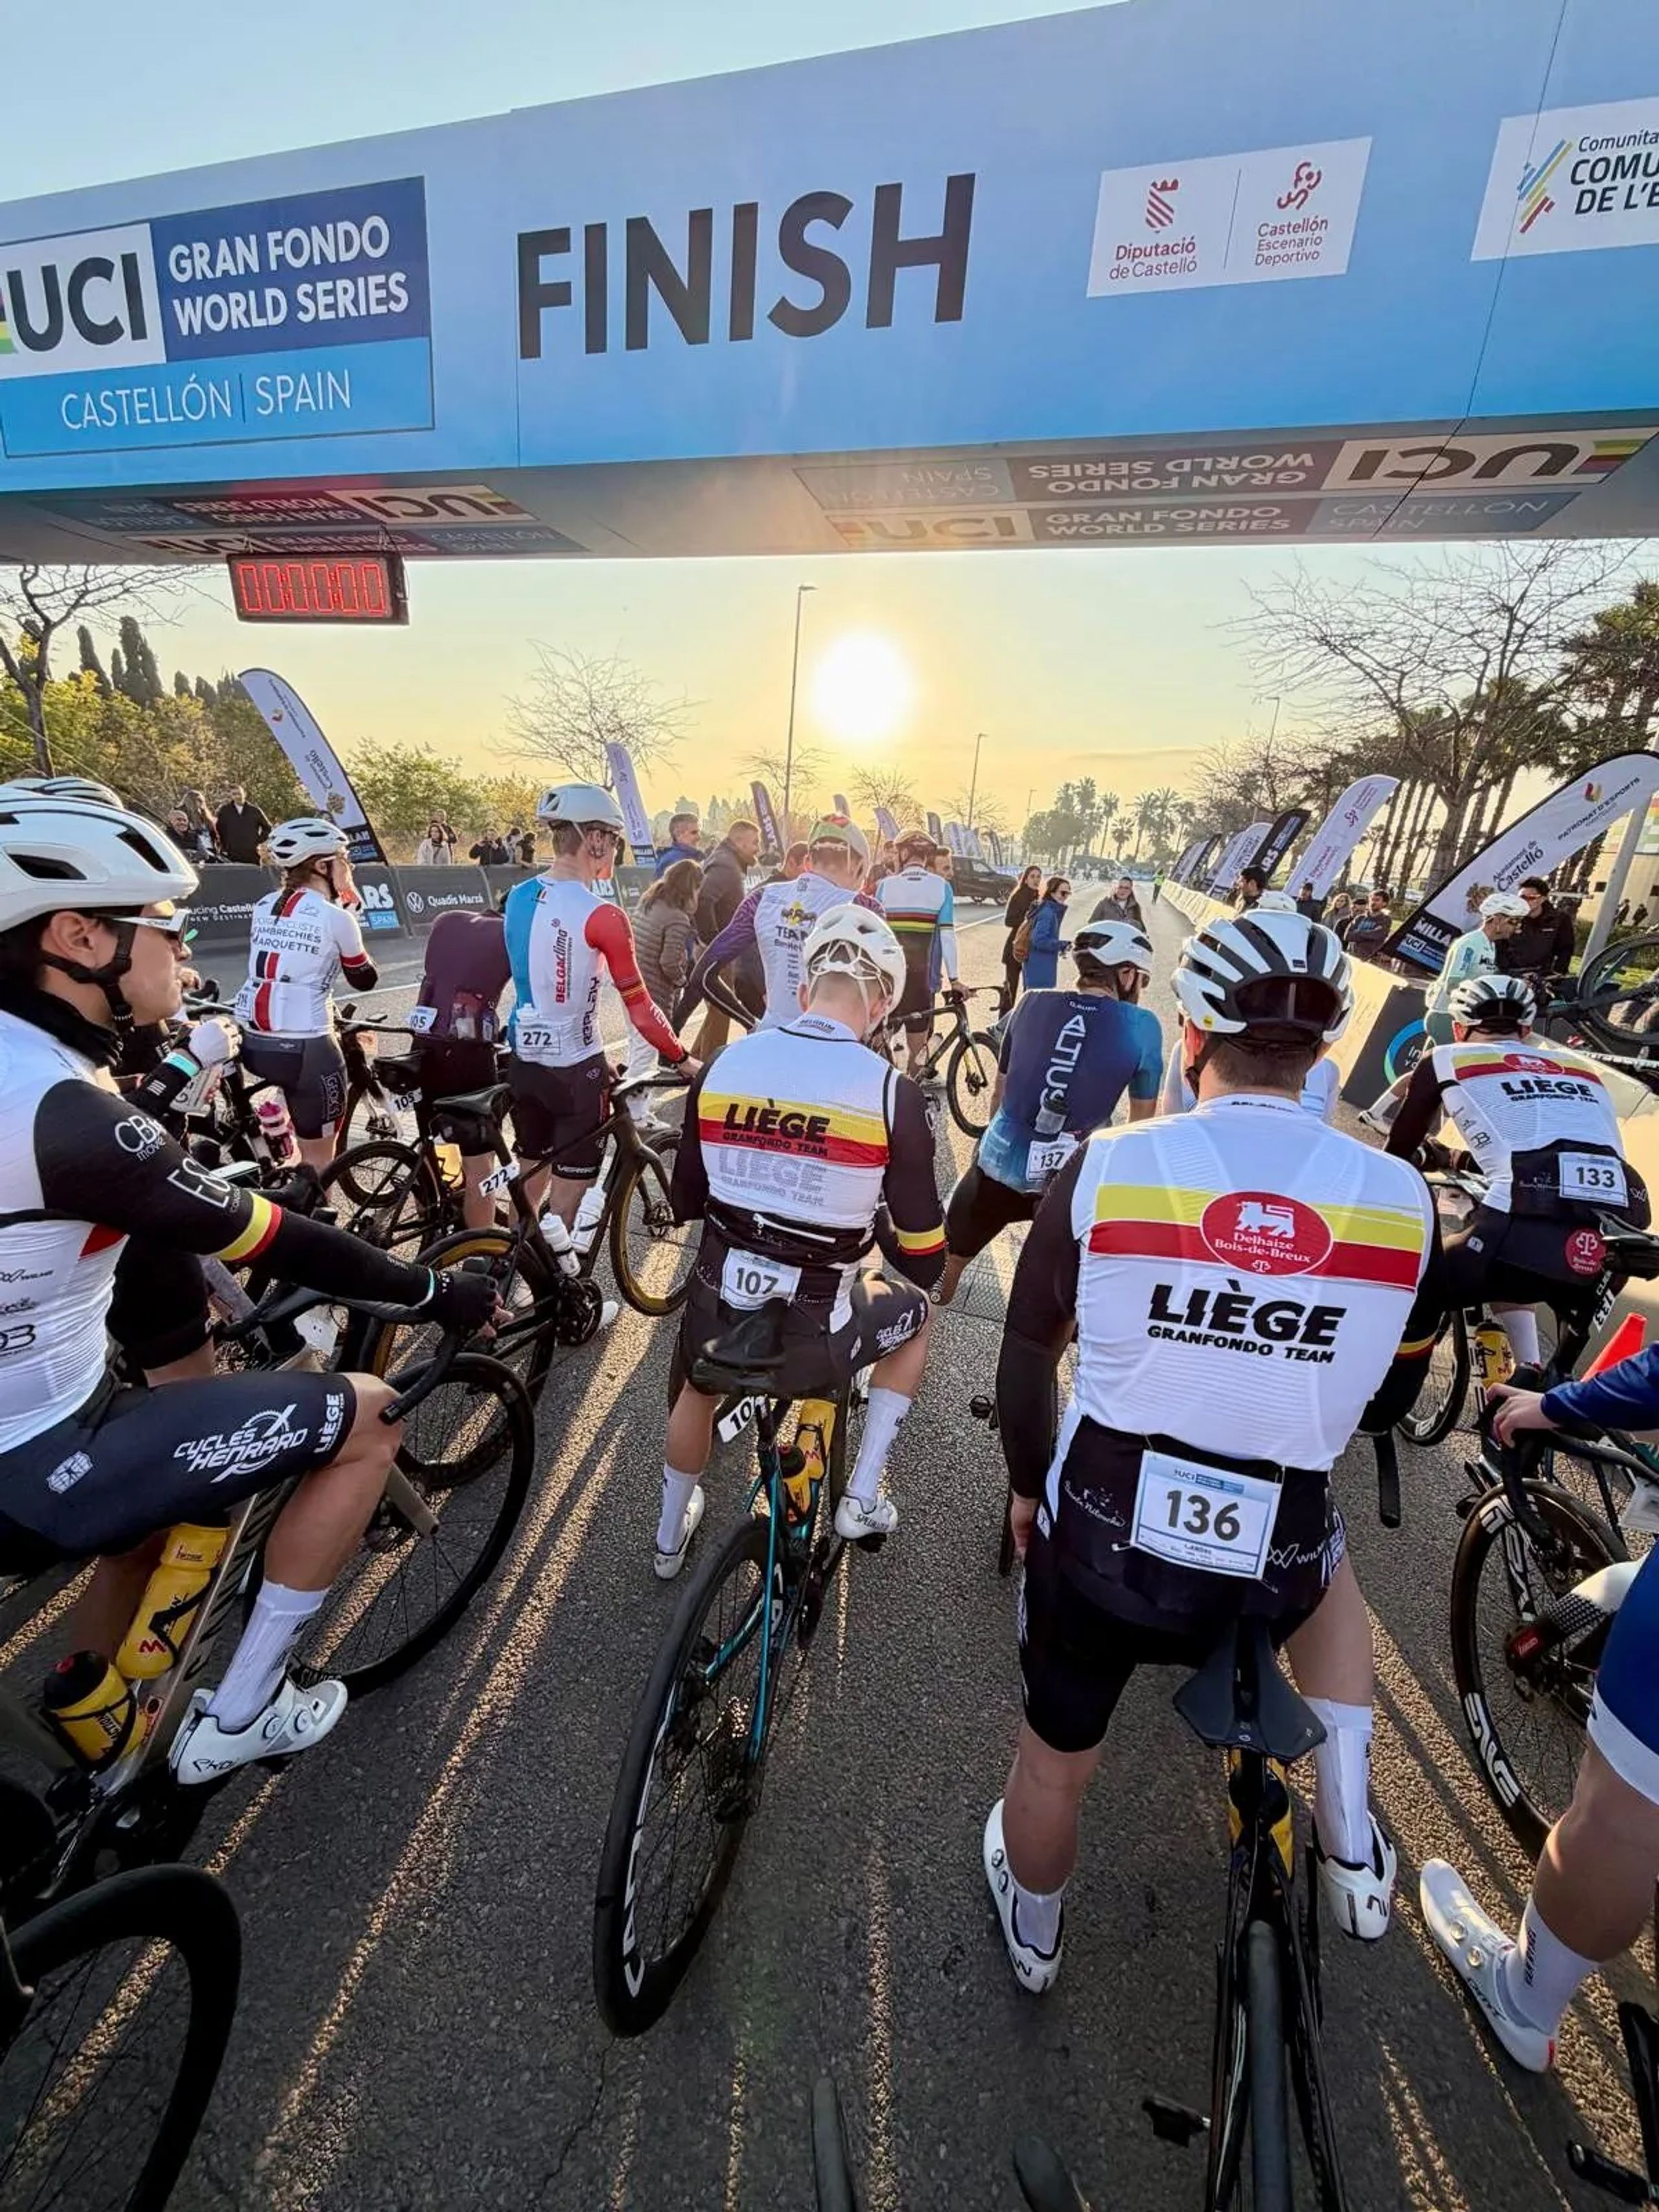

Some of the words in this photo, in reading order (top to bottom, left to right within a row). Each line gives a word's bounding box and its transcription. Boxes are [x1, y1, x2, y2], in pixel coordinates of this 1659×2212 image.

[1570, 152, 1659, 185] COMU
[1575, 186, 1618, 215] DE
[1257, 215, 1328, 238] Castellón
[168, 233, 259, 283] GRAN
[268, 215, 390, 272] FONDO
[1115, 235, 1196, 261] Diputació
[1257, 232, 1323, 252] Escenario
[517, 172, 976, 360] FINISH
[1109, 264, 1131, 281] de
[1132, 255, 1198, 279] Castelló
[1255, 249, 1321, 267] Deportivo
[6, 252, 150, 353] UCI
[172, 287, 288, 336] WORLD
[297, 272, 409, 323] SERIES
[61, 373, 232, 430] CASTELLÓN
[256, 369, 352, 415] SPAIN
[1028, 460, 1156, 479] SERIES
[1165, 452, 1316, 472] WORLD
[1347, 443, 1581, 482] UCI
[1047, 475, 1179, 494] FONDO
[1191, 470, 1308, 489] GRAN
[352, 493, 500, 518] UCI
[1045, 510, 1143, 524] GRAN
[1152, 507, 1282, 521] FONDO
[867, 517, 1017, 540] UCI
[1047, 523, 1166, 535] WORLD
[1174, 518, 1291, 533] SERIES
[1497, 846, 1545, 892] Castelló
[522, 1030, 553, 1047] 272
[1500, 1075, 1594, 1097] LIÈGE
[393, 1092, 415, 1112] 105
[723, 1098, 831, 1145] LIÈGE
[796, 1142, 829, 1158] TEAM
[1039, 1151, 1064, 1169] 137
[481, 1169, 510, 1194] 272
[1575, 1166, 1617, 1189] 133
[1214, 1239, 1313, 1264] Bois-de-Breux
[1233, 1231, 1295, 1251] Delhaize
[736, 1267, 780, 1296] 107
[1148, 1279, 1348, 1347] LIÈGE
[1147, 1325, 1274, 1356] GRANFONDO
[1284, 1345, 1336, 1364] TEAM
[174, 1426, 258, 1460] CYCLES
[187, 1428, 308, 1473] HENRARD
[1166, 1489, 1242, 1542] 136
